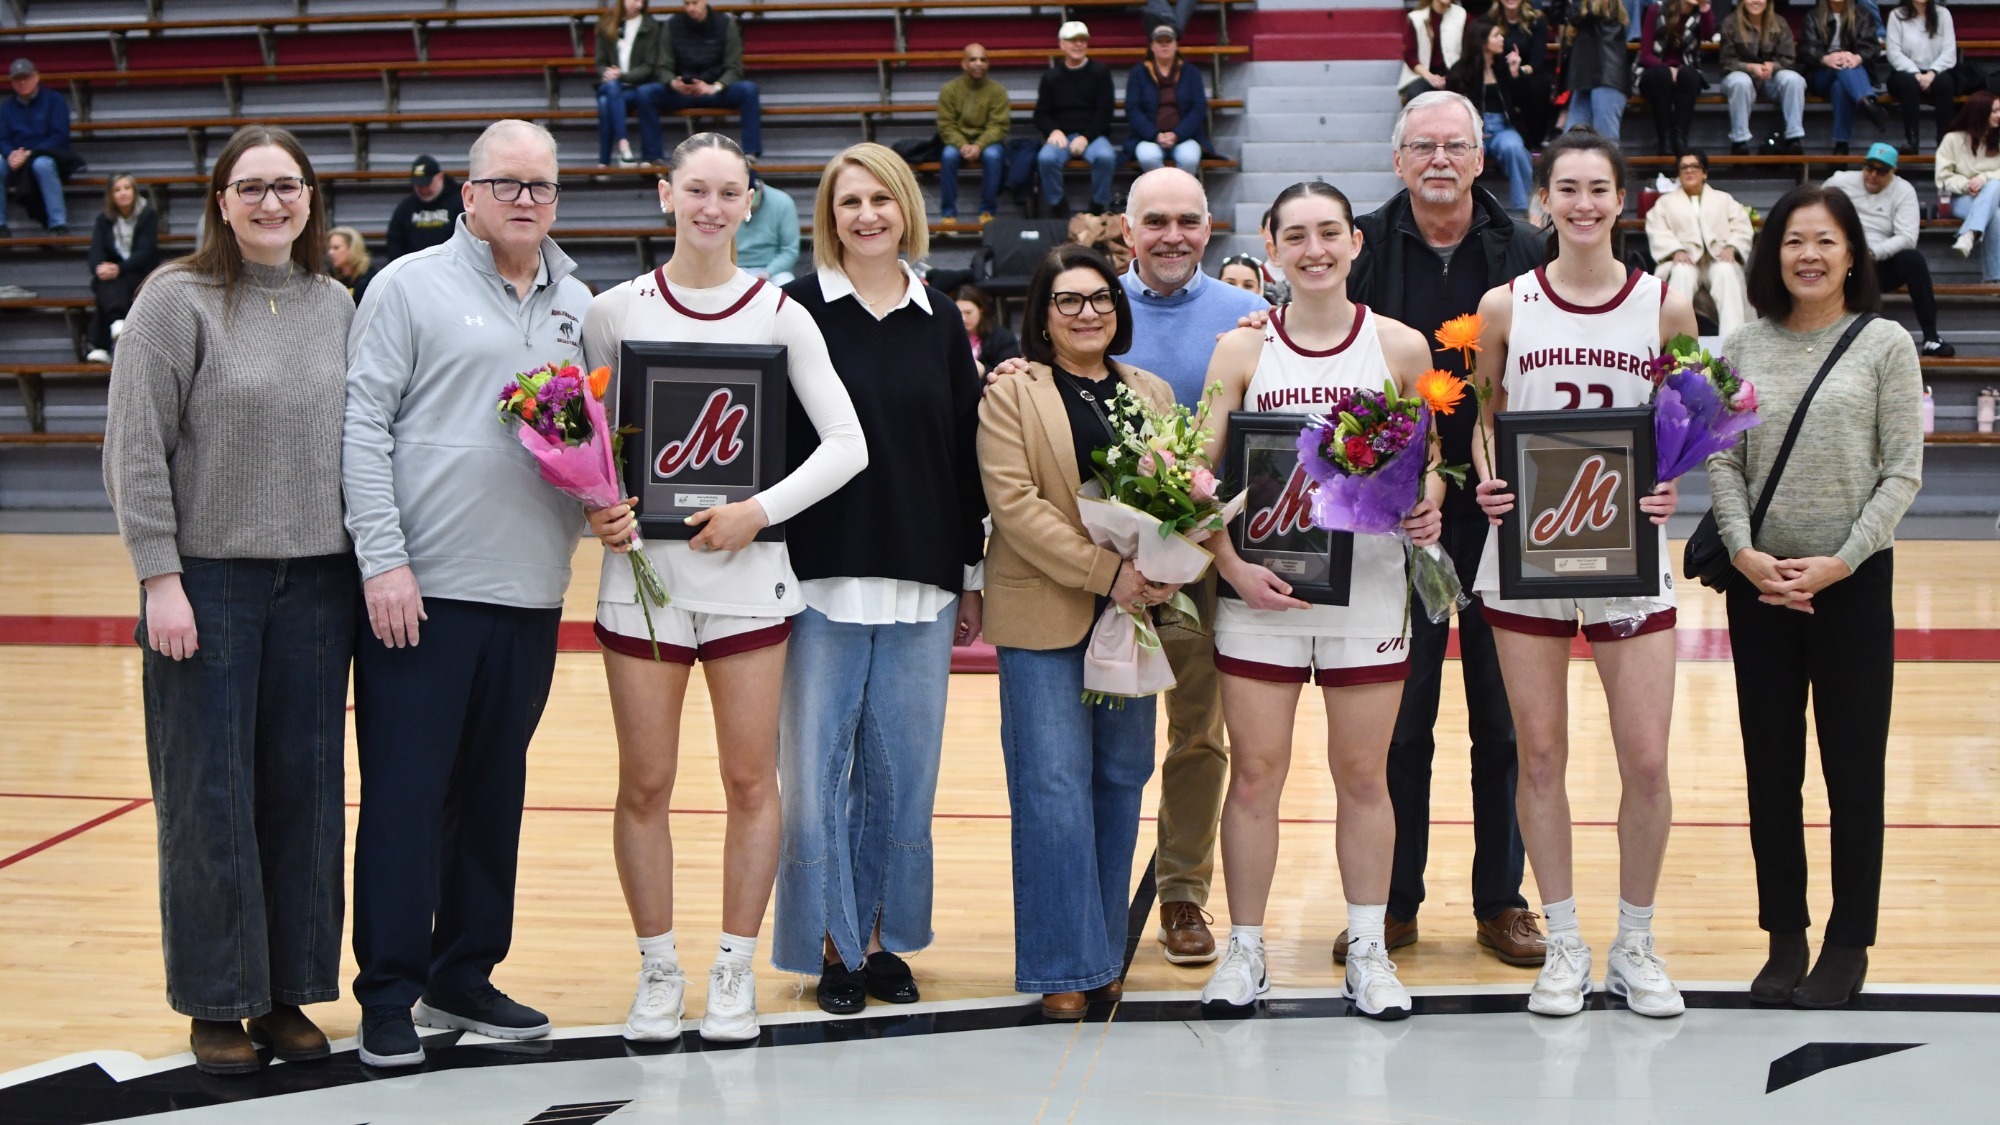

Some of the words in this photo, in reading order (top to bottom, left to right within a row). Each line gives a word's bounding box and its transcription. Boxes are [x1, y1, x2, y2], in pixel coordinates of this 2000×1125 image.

[1519, 347, 1652, 381] MUHLENBERG
[1257, 386, 1360, 413] MUHLENB
[654, 387, 748, 478] M
[1530, 454, 1622, 546] M
